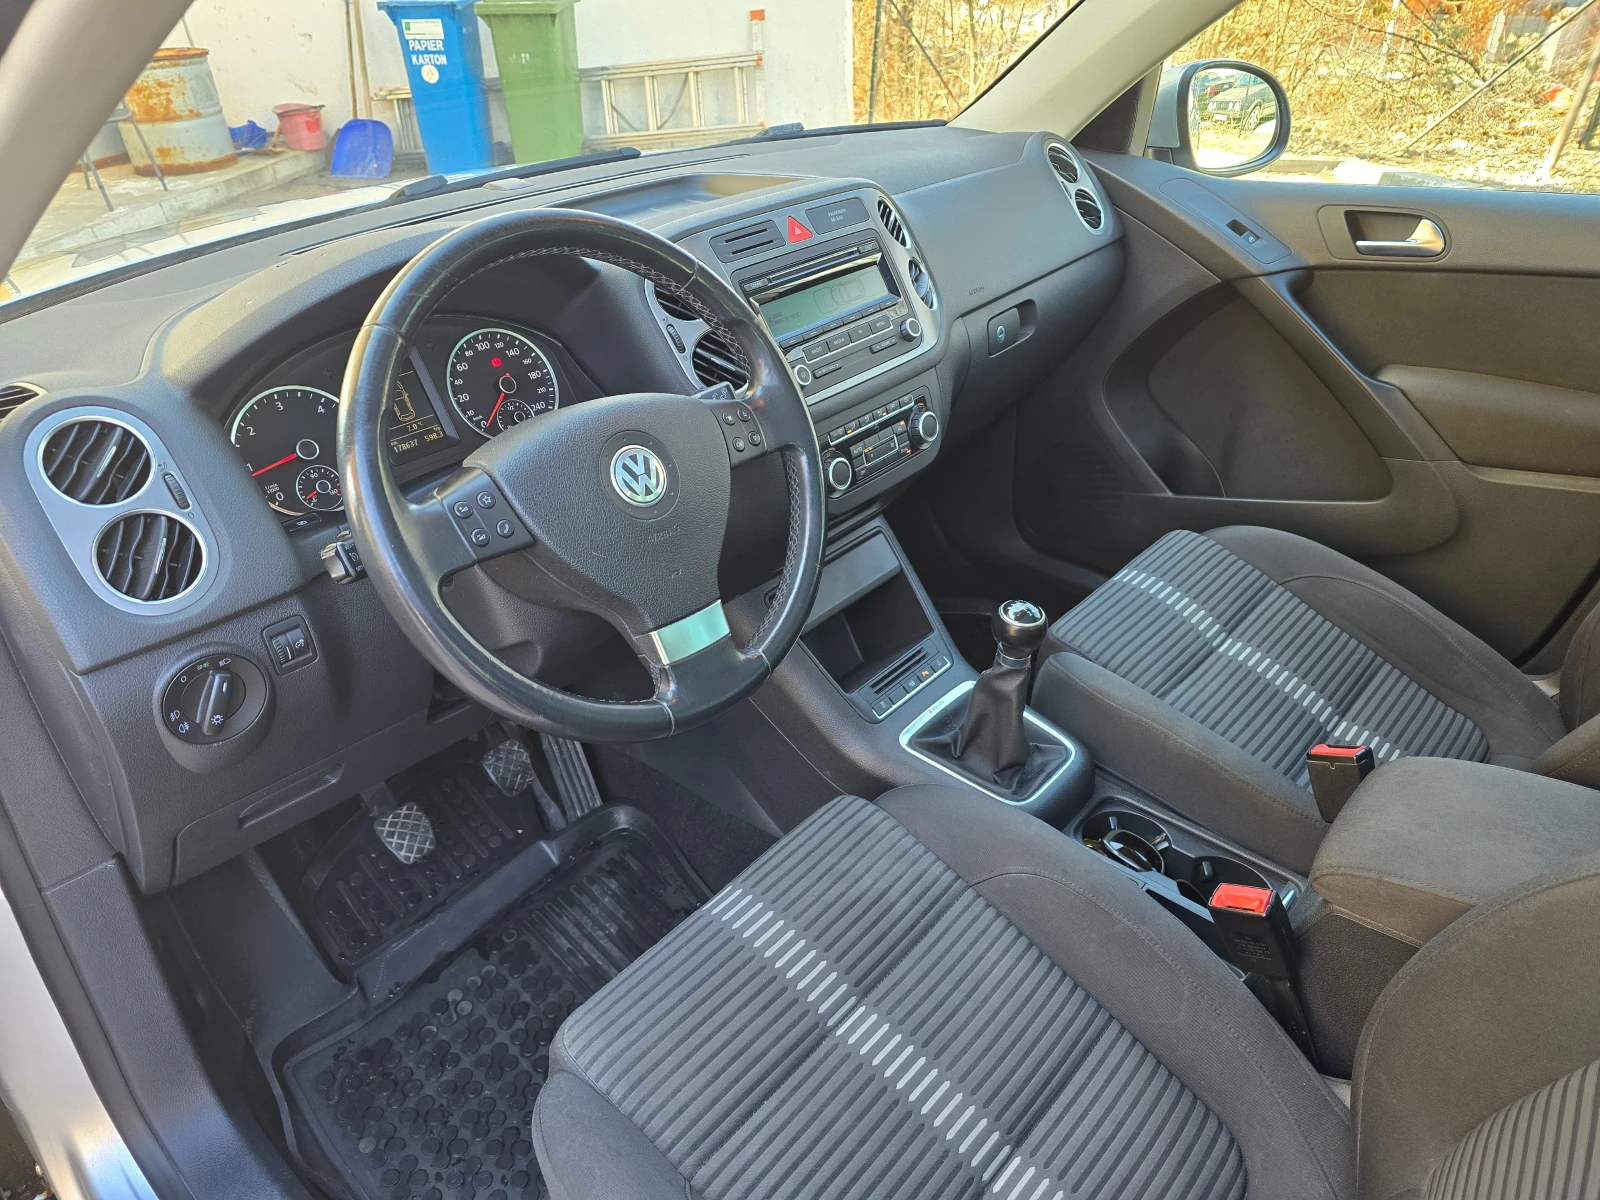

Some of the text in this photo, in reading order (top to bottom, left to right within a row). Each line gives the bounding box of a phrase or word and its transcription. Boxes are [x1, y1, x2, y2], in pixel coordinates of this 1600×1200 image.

[409, 40, 444, 51] PAPIER
[411, 54, 447, 65] KARTON
[475, 341, 490, 351] 100
[494, 341, 505, 349] 120
[506, 347, 520, 358] 140
[456, 362, 469, 371] 60
[528, 370, 541, 380] 180
[458, 393, 470, 403] 20
[275, 401, 284, 411] 3
[317, 405, 326, 414] 4
[531, 401, 546, 411] 240
[466, 409, 475, 417] 10
[246, 426, 256, 436] 2
[407, 423, 418, 432] 7.0
[424, 430, 444, 442] 598.3
[393, 439, 418, 453] 178637
[246, 463, 254, 472] 1
[310, 472, 318, 480] 90
[275, 491, 284, 501] 0
